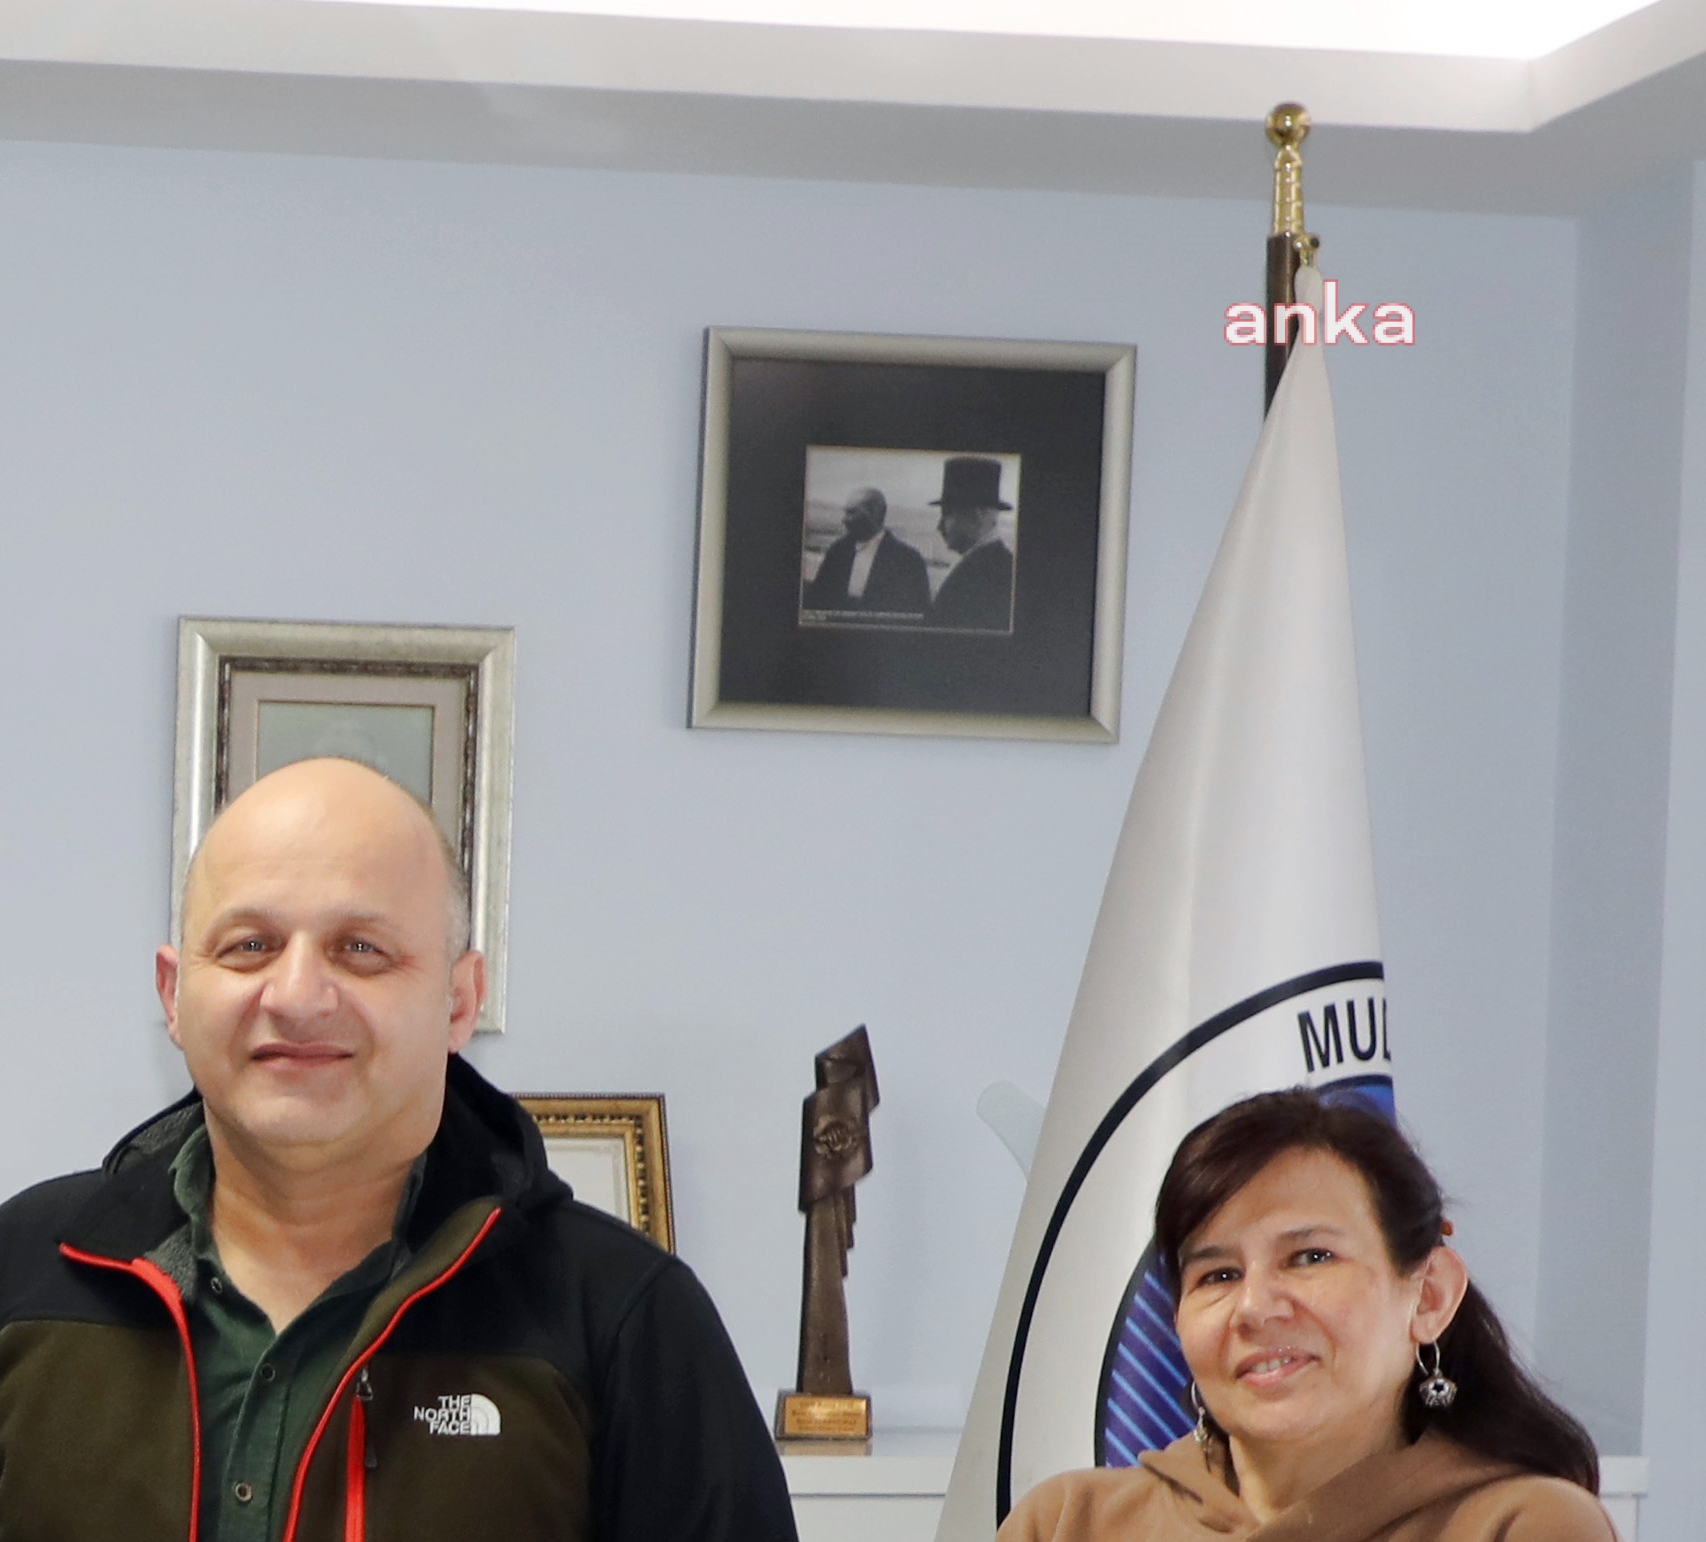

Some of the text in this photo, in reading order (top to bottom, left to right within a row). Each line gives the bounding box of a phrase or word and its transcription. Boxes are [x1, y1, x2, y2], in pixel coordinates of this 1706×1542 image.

[437, 1394, 471, 1410] THE
[414, 1405, 471, 1422] NORTH
[429, 1420, 471, 1435] FACE
